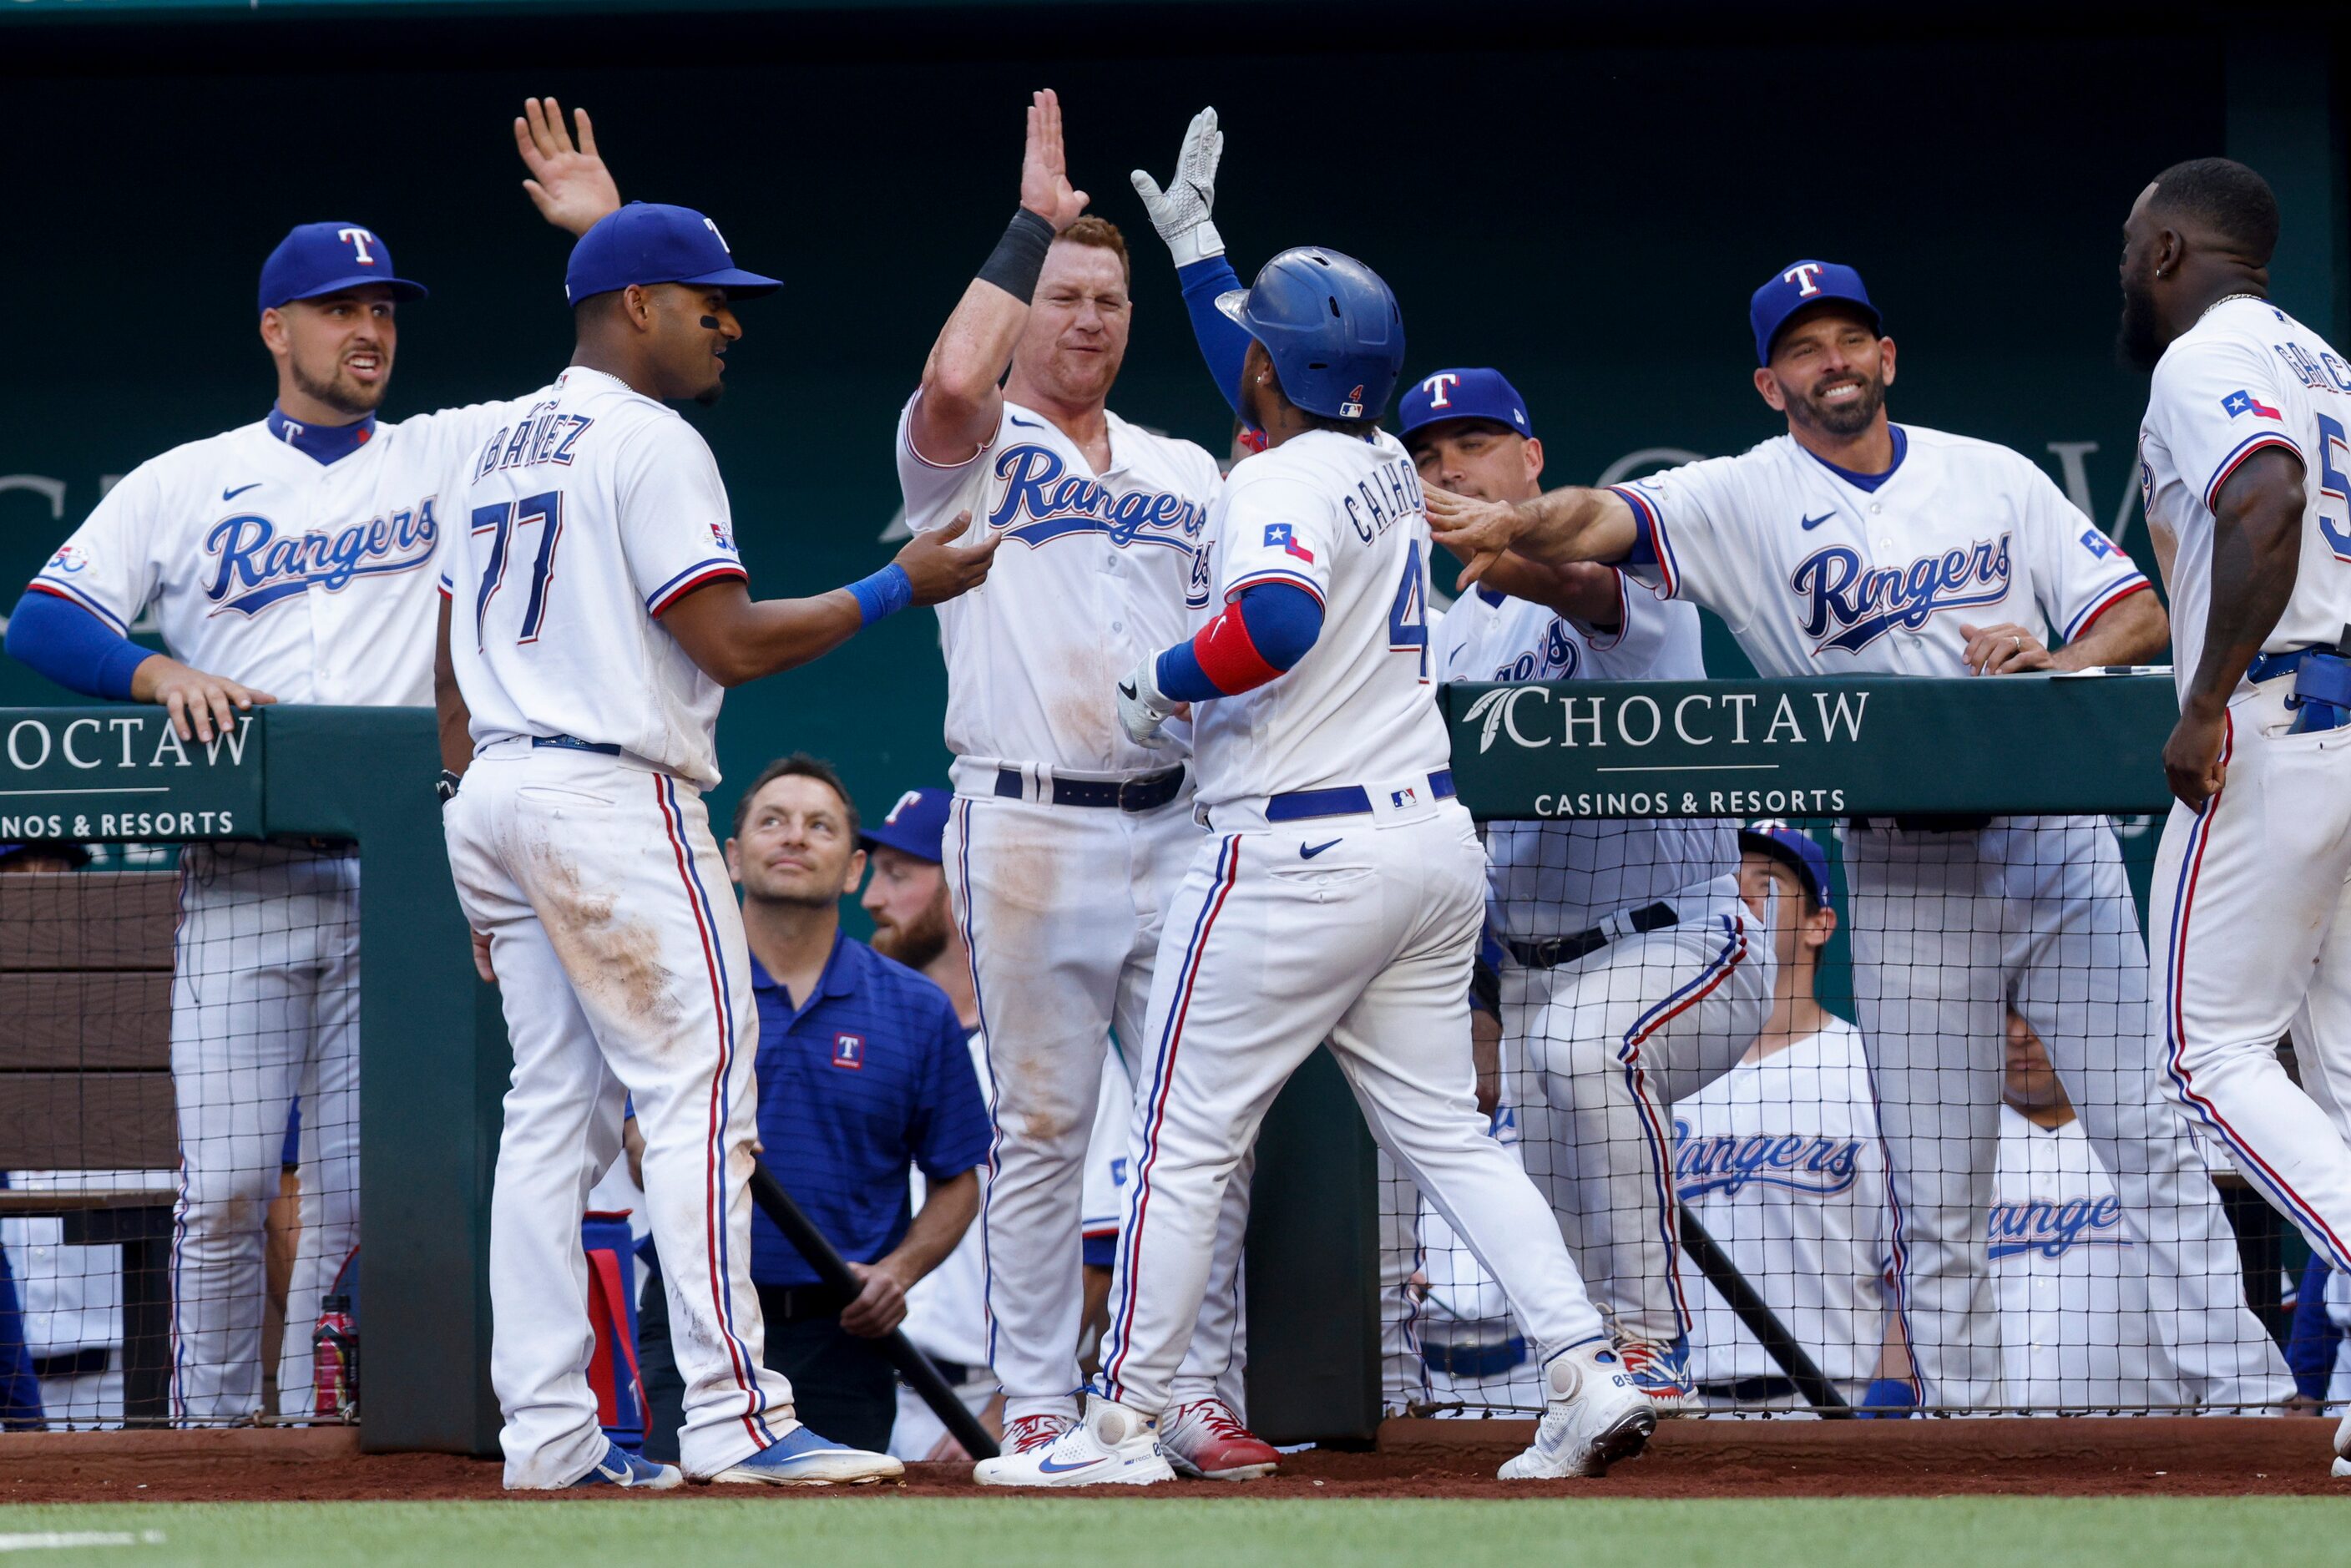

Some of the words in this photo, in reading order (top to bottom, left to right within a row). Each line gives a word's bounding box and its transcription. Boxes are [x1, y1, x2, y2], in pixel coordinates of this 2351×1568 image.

[337, 227, 375, 266] T
[1782, 263, 1823, 299] T
[1348, 384, 1364, 402] 4
[1423, 373, 1461, 410] T
[201, 494, 440, 614] Rangers
[471, 489, 564, 655] 77
[1789, 531, 2013, 650] Rangers
[1388, 539, 1430, 685] 4
[1503, 685, 1870, 748] CHOCTAW
[7, 716, 254, 771] OCTAW
[884, 790, 923, 827] T
[1534, 792, 1669, 817] CASINOS
[1681, 792, 1698, 814] &
[1710, 788, 1845, 813] RESORTS
[1, 814, 63, 837] NOS
[72, 814, 91, 837] &
[101, 811, 234, 836] RESORTS
[838, 1035, 859, 1059] T
